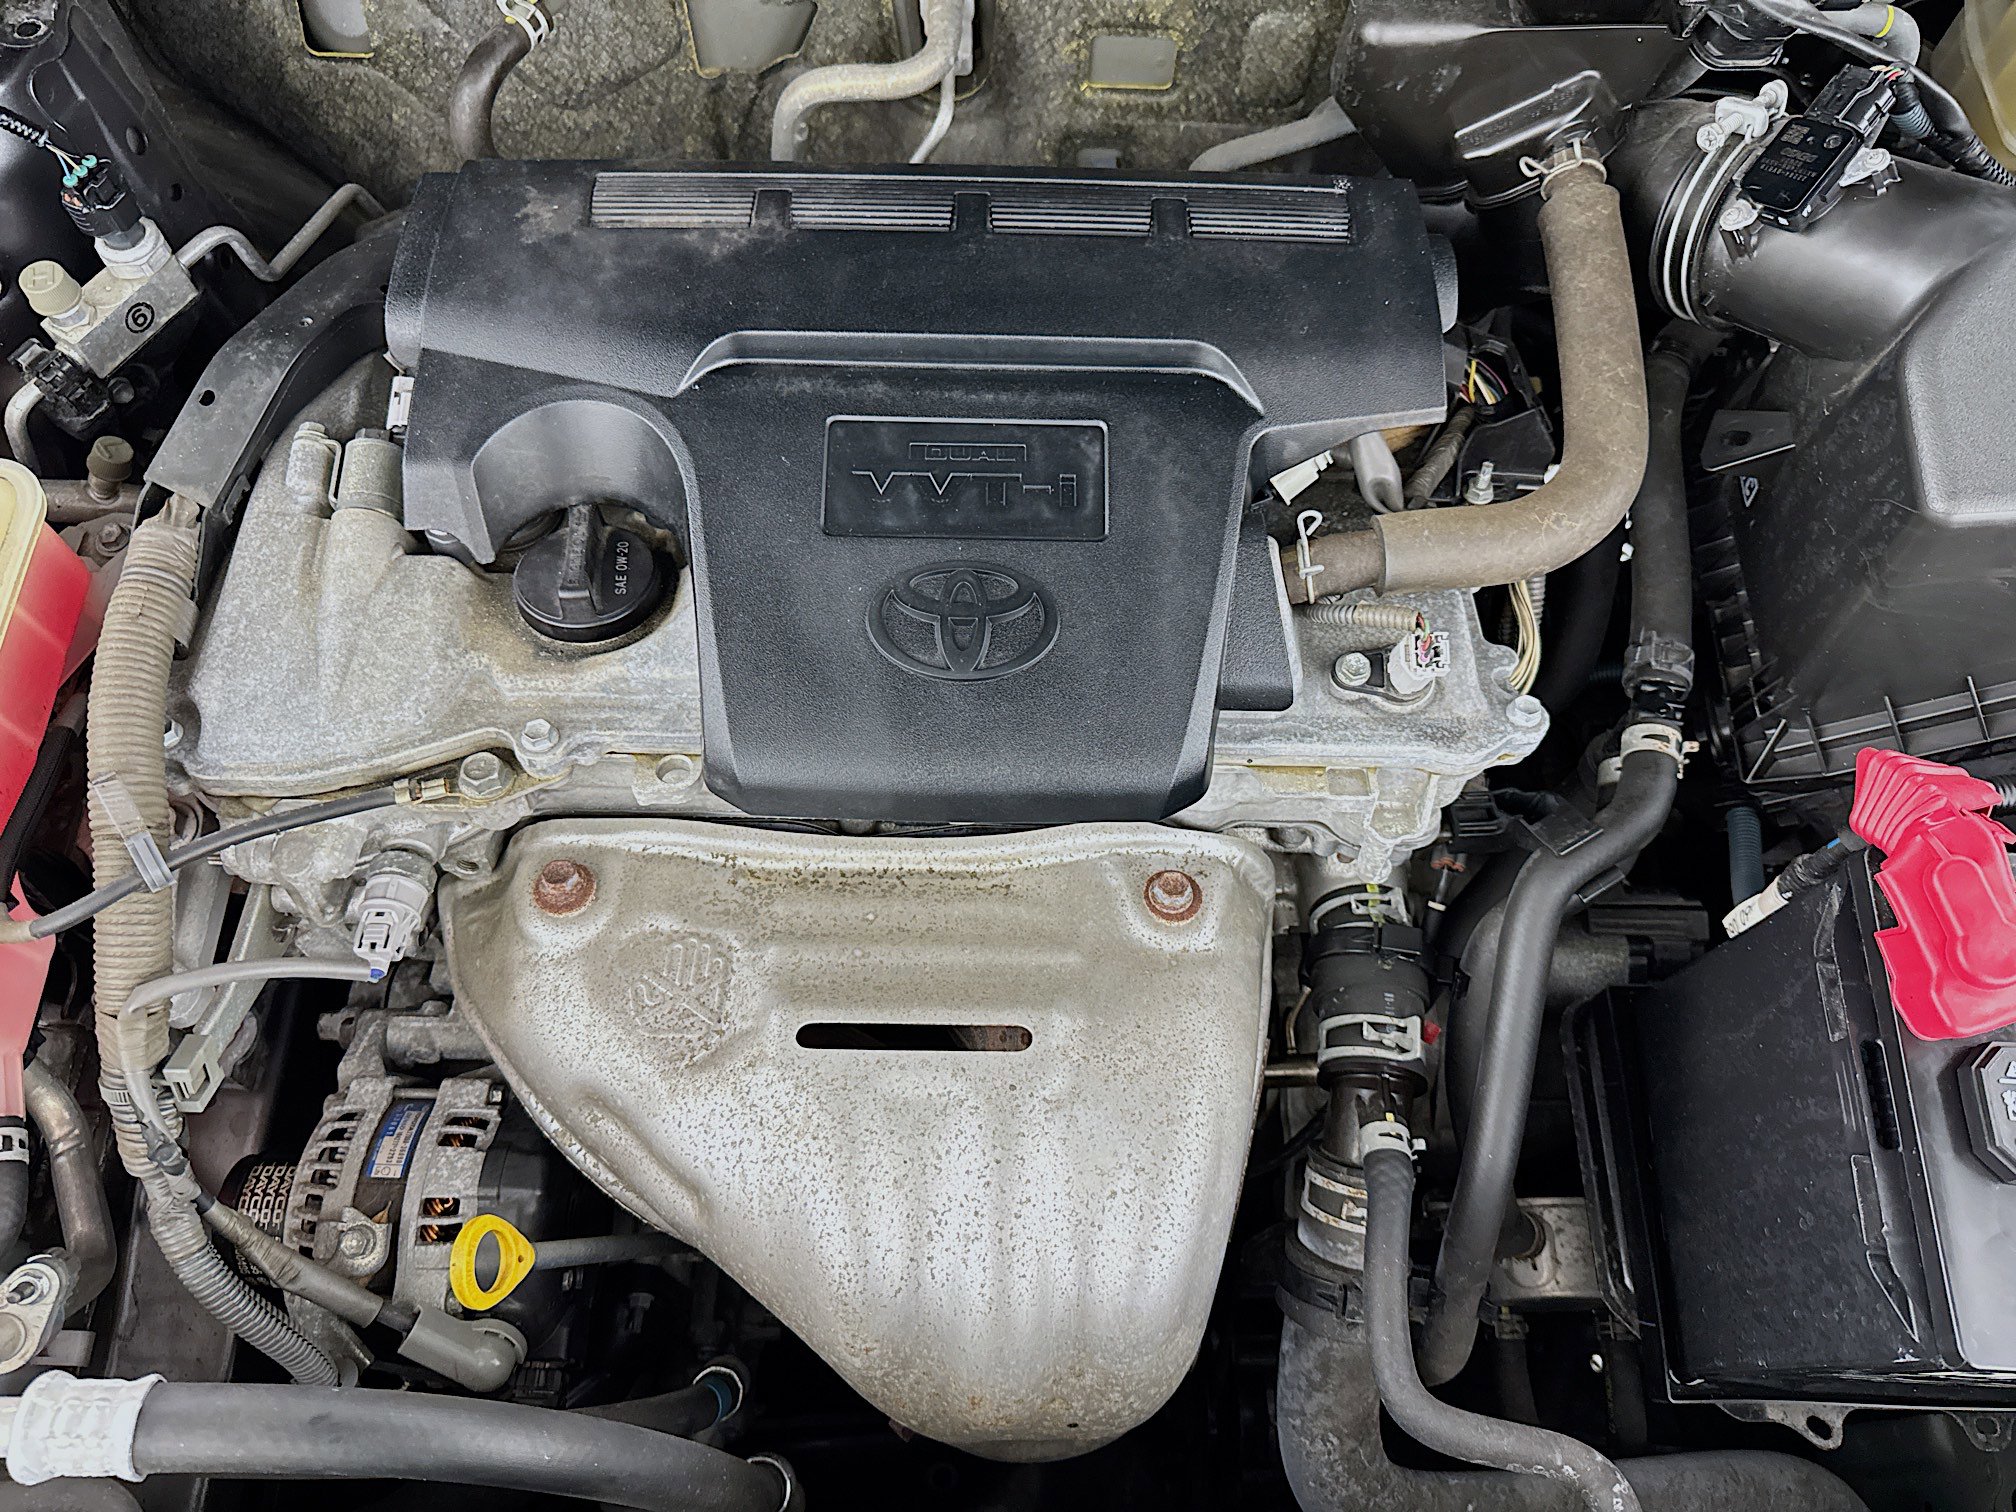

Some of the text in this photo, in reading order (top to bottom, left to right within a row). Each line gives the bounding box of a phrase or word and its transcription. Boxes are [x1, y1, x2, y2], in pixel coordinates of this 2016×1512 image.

[27, 265, 55, 288] H
[924, 445, 1017, 461] DUAL
[851, 470, 1077, 507] VVT-i
[614, 541, 630, 595] SAE 0W-20
[260, 1162, 288, 1224] DAYCO
